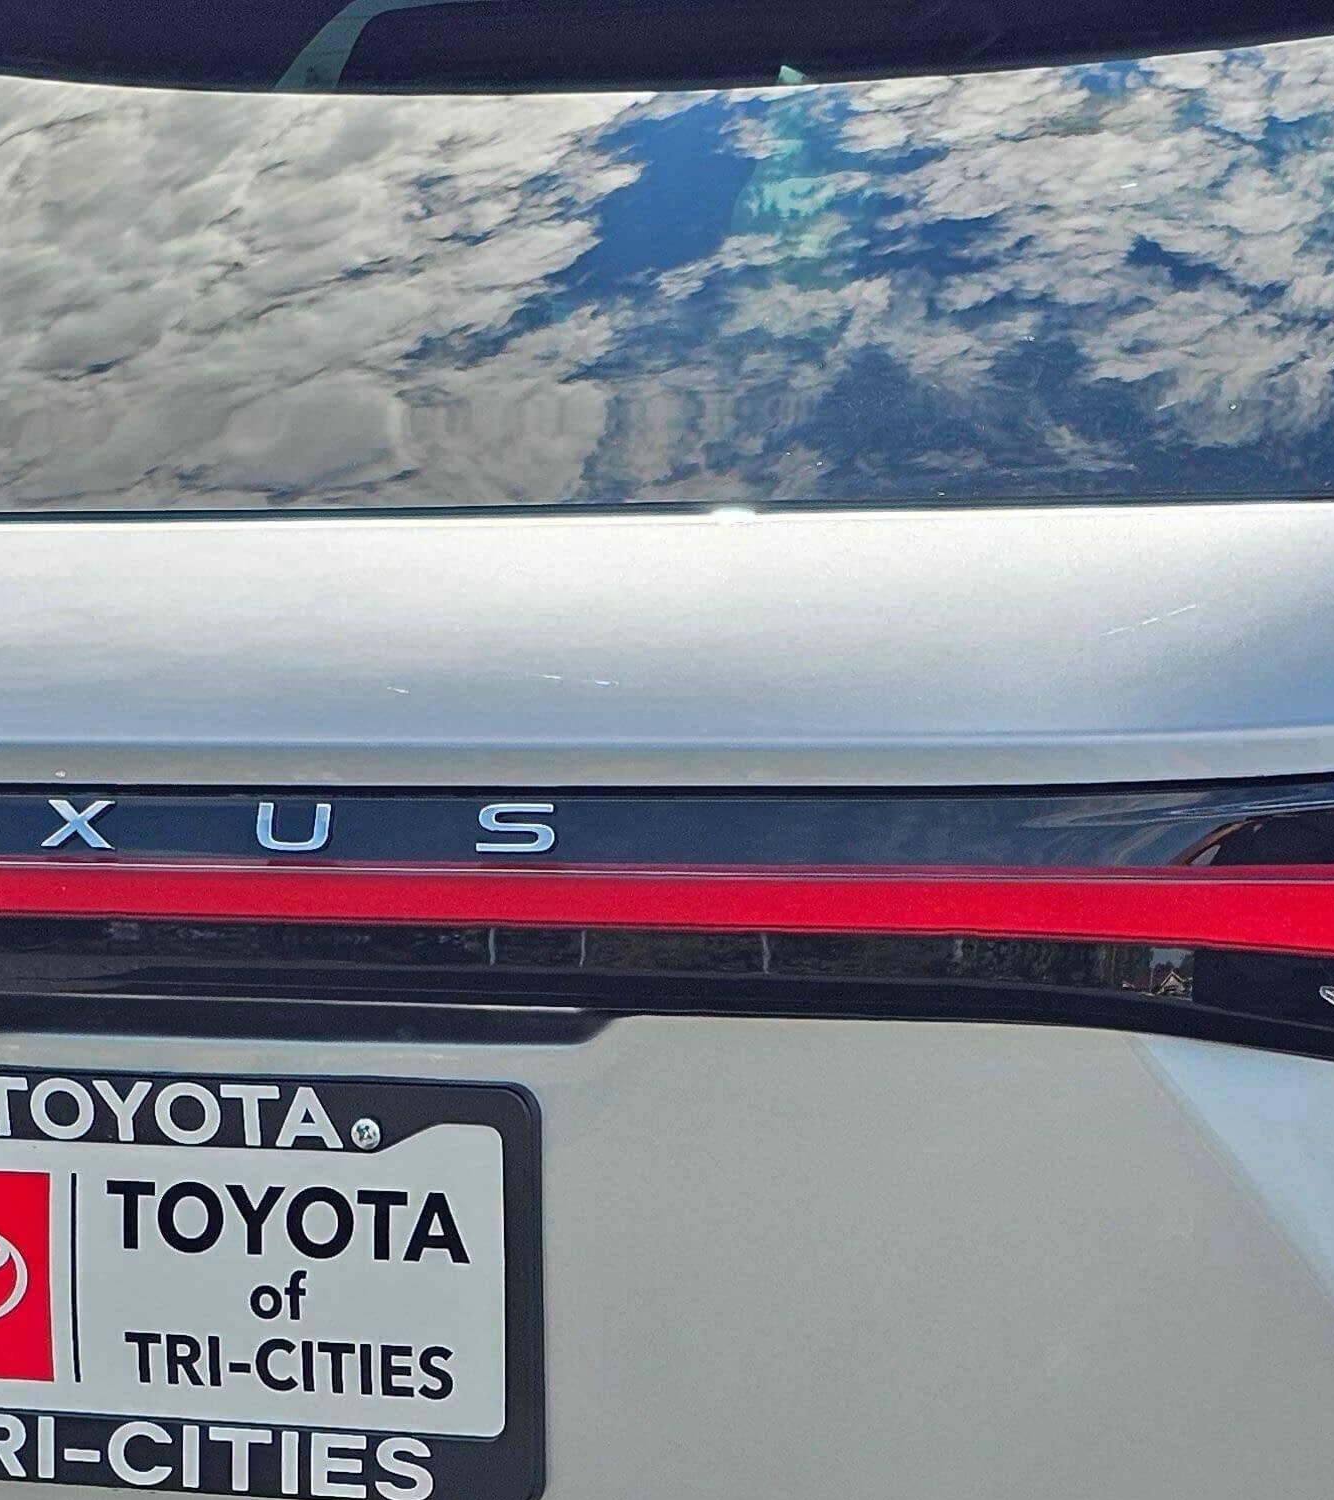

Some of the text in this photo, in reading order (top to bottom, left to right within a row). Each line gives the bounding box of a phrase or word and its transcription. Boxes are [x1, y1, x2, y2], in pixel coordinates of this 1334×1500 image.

[106, 1179, 471, 1265] TOYOTA
[249, 1270, 307, 1321] of
[124, 1332, 455, 1401] TRI-CITIES
